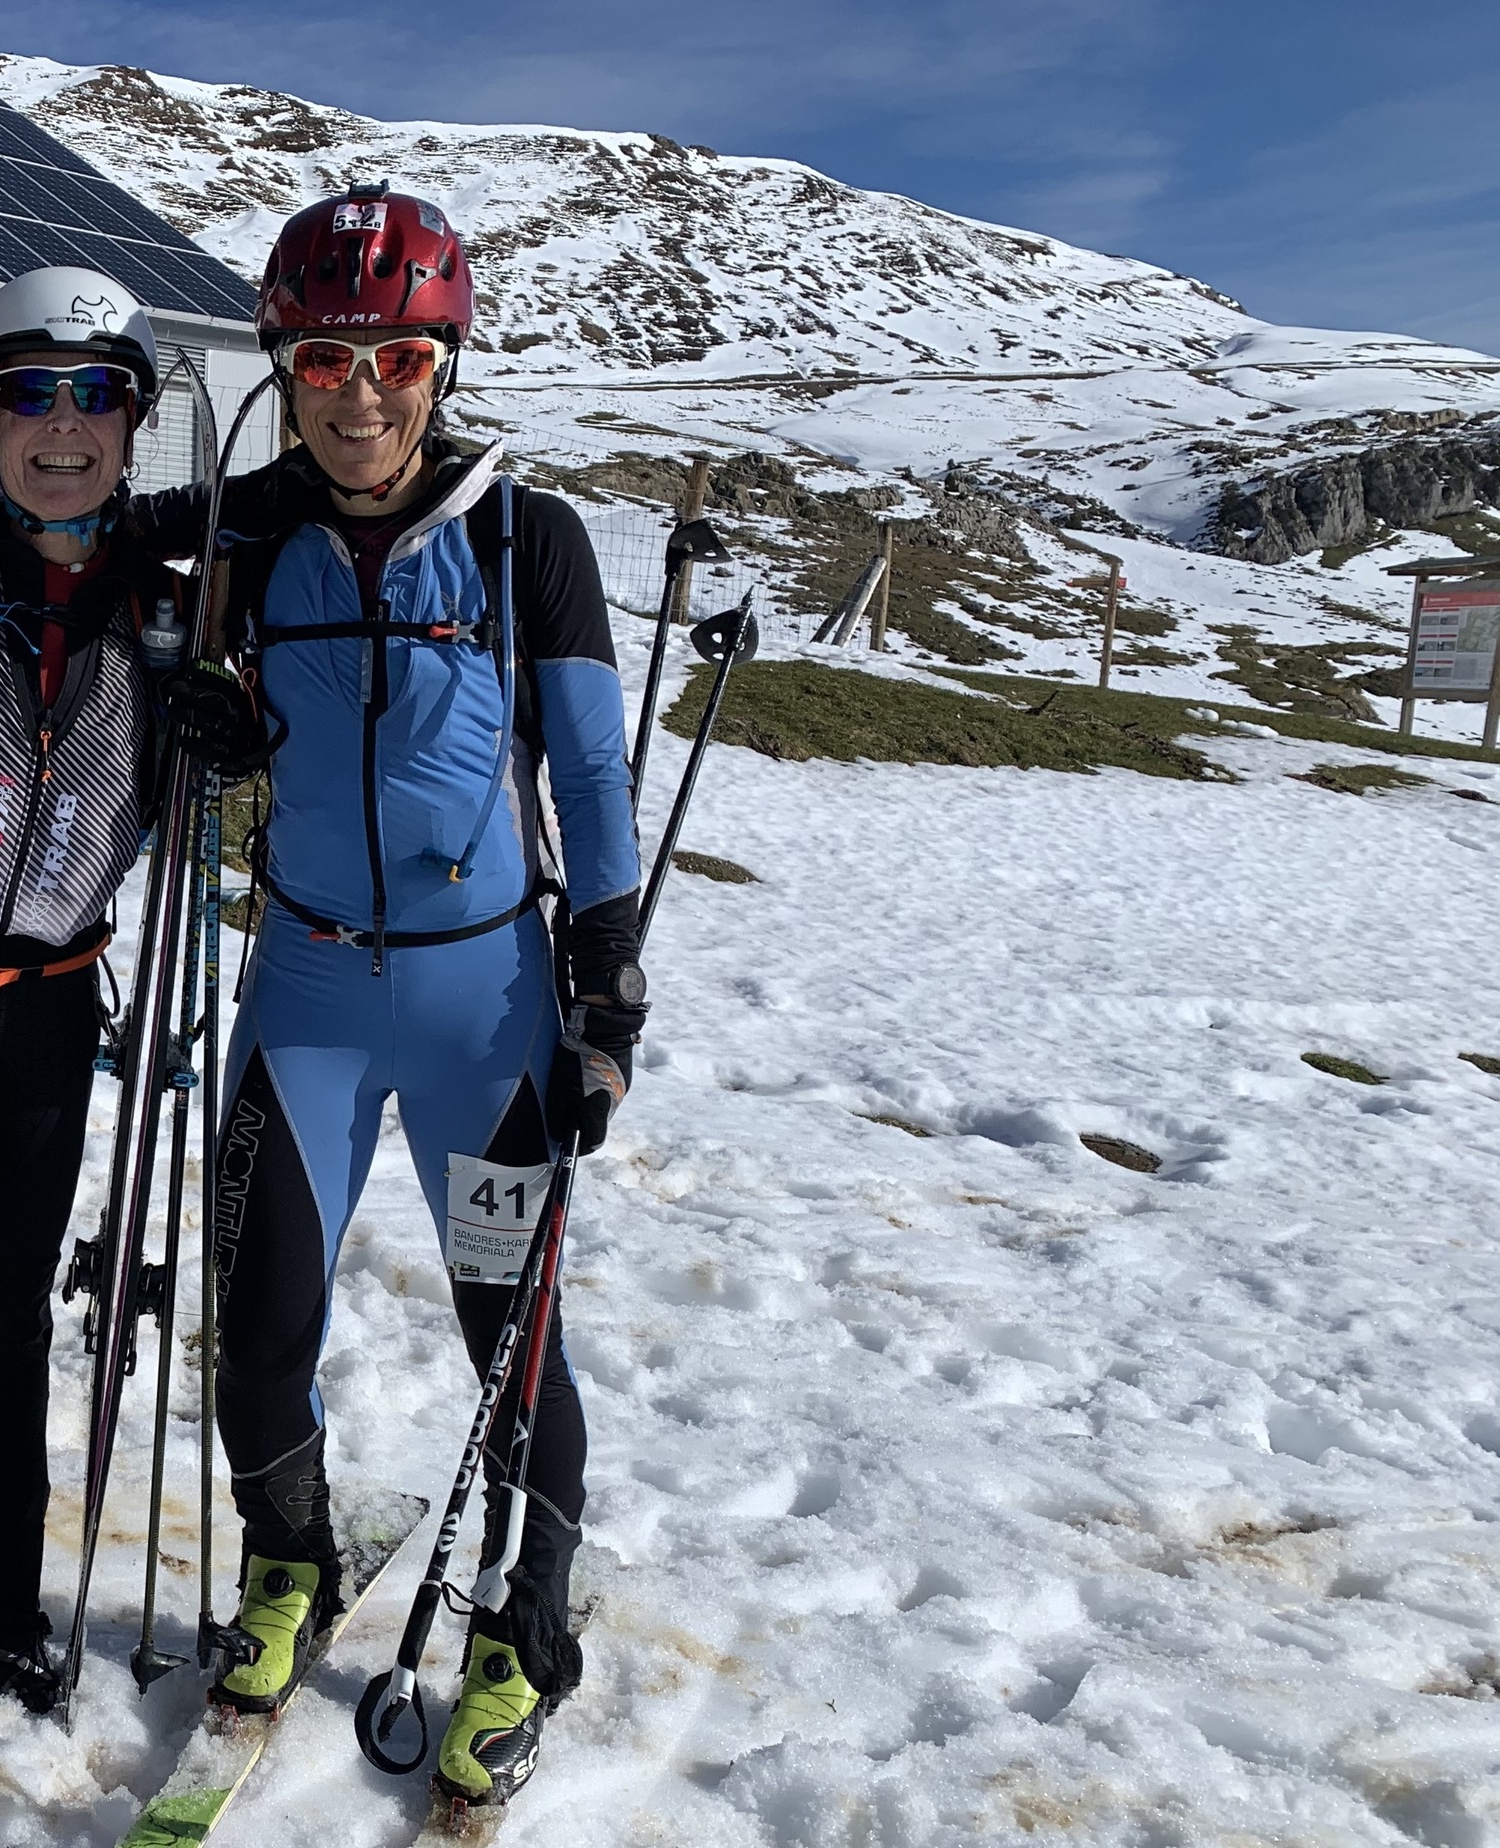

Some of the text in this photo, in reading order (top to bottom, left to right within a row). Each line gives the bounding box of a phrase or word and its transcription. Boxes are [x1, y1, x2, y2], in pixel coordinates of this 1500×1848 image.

[321, 312, 382, 325] CAMP
[469, 1177, 525, 1219] 41
[454, 1238, 516, 1258] MEMORIALA
